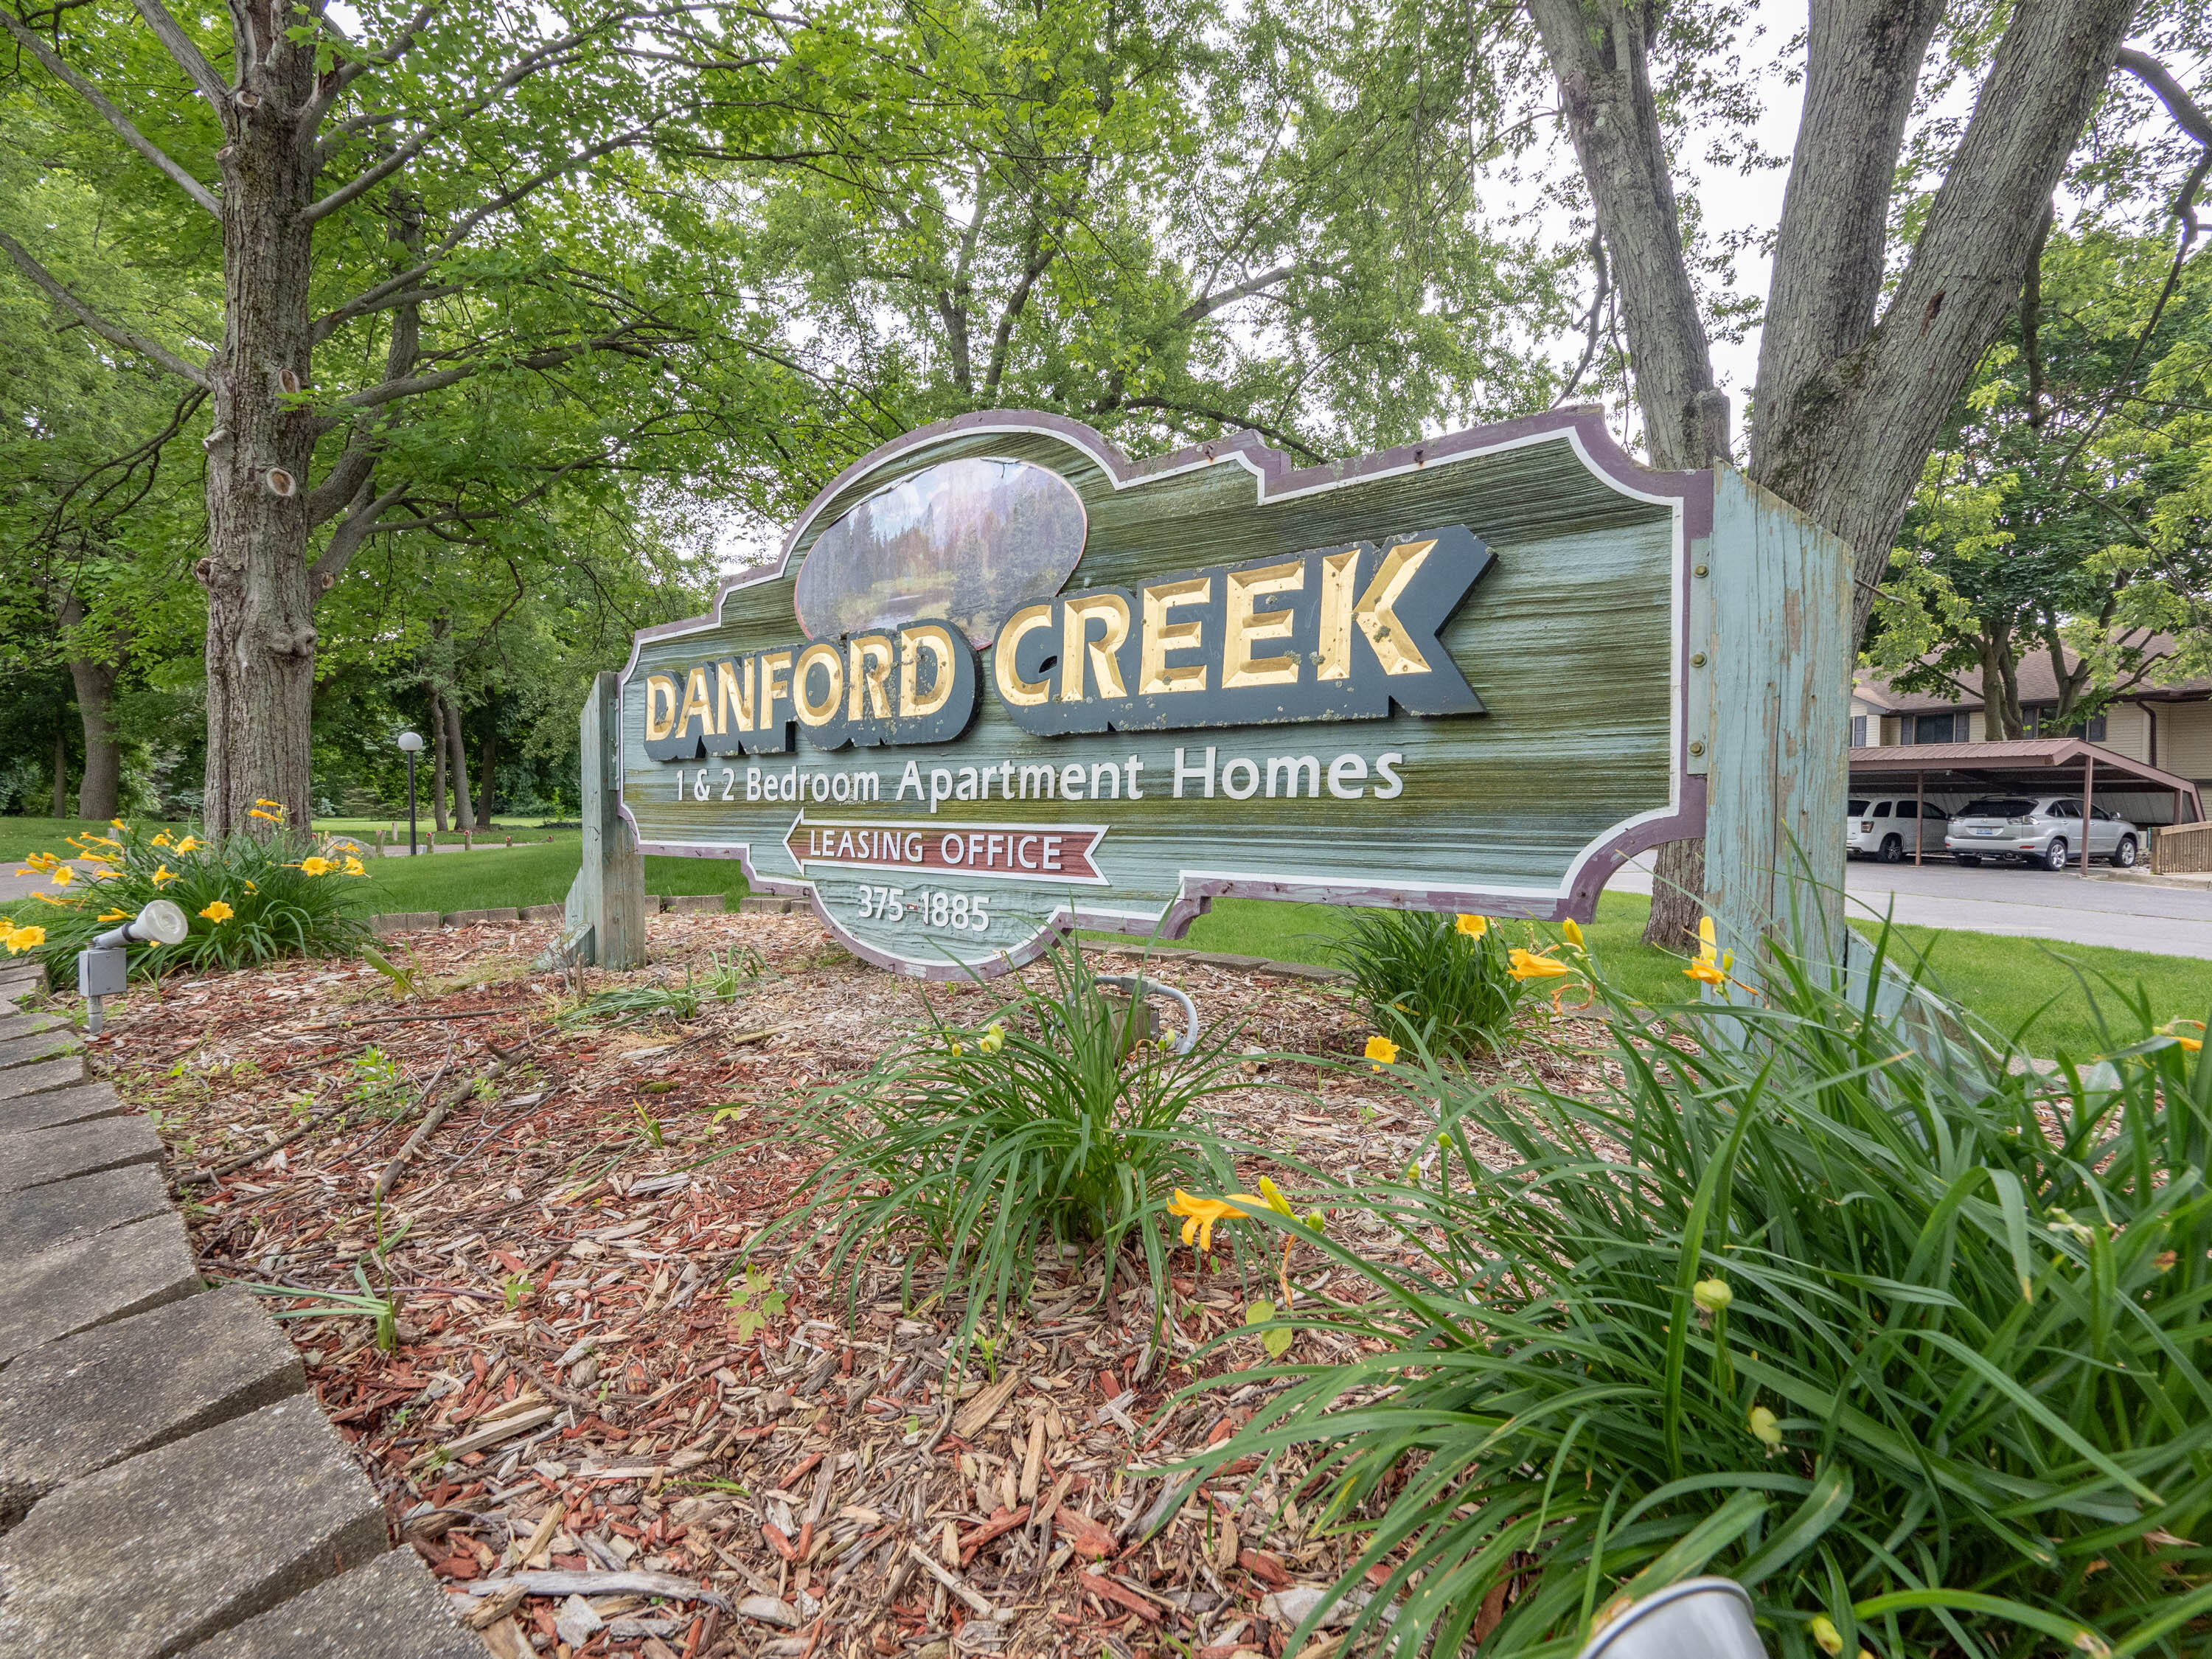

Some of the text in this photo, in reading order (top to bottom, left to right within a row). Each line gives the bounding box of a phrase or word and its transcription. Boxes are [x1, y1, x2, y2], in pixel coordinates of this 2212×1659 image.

[646, 539, 1438, 741] DANFORD CREEK
[676, 747, 1402, 813] 1 & 2 Bedroom Apartment Homes
[810, 830, 1062, 870] LEASING OFFICE
[858, 885, 990, 932] 375-1885
